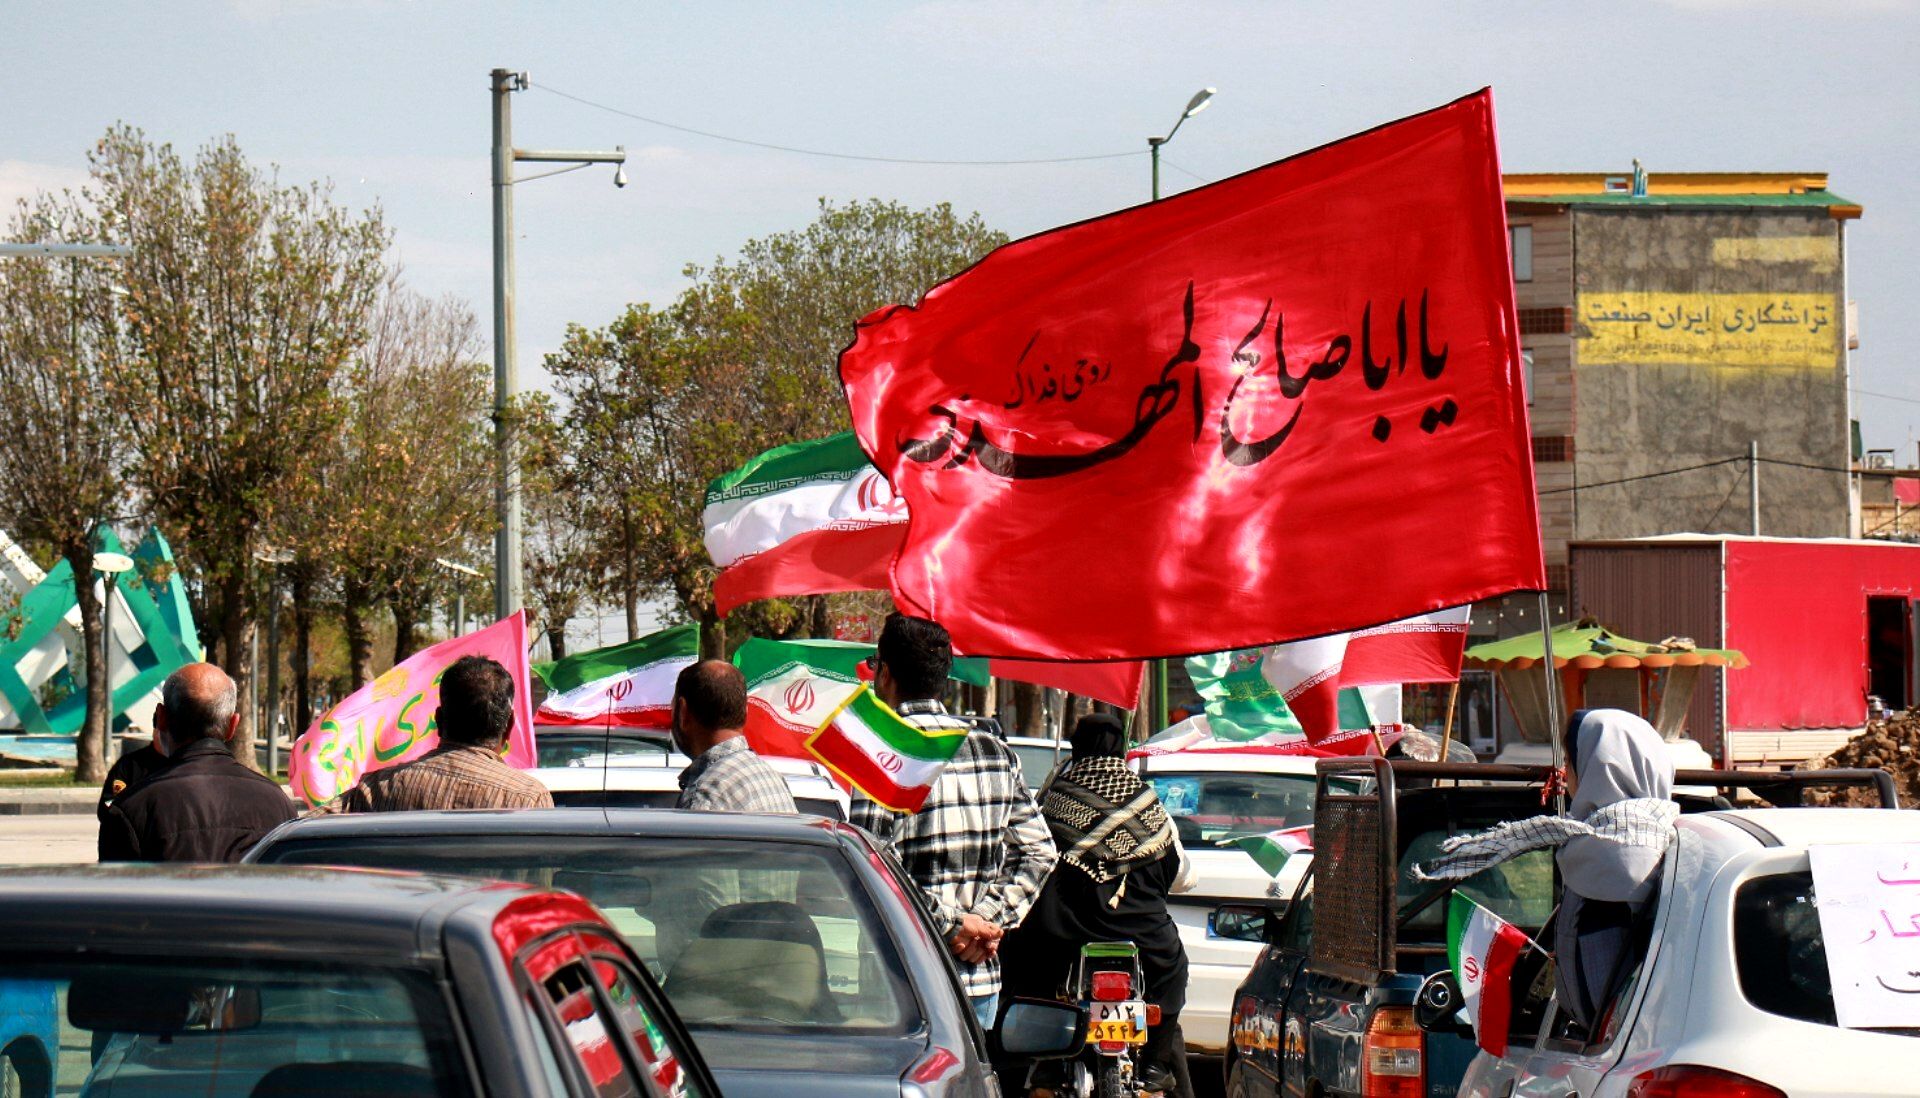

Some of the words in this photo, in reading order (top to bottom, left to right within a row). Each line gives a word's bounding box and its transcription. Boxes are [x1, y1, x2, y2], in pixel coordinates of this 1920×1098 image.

[1587, 301, 1651, 323] صنعت
[1656, 304, 1710, 335] ایران
[1722, 300, 1828, 334] تراشکاری
[1418, 286, 1459, 434] یا
